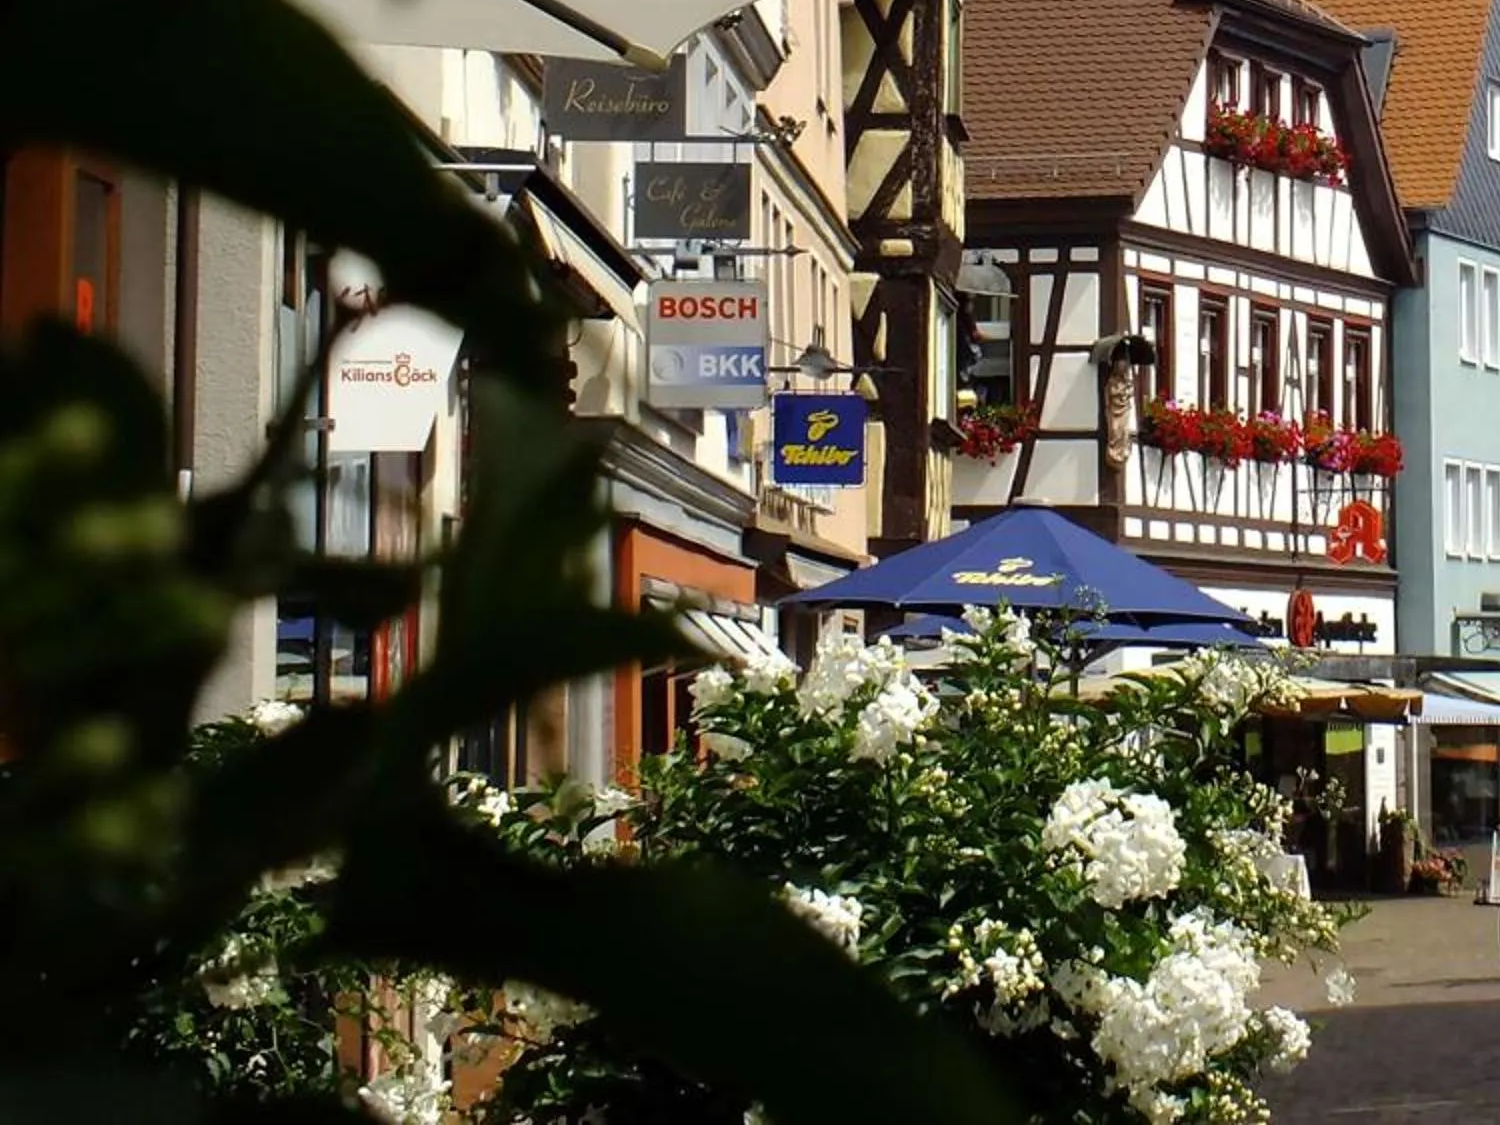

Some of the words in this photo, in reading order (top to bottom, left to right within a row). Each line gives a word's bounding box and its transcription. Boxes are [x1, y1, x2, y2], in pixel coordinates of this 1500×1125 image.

[659, 296, 758, 319] BOSCH
[701, 353, 761, 377] BKK
[780, 443, 859, 466] Tchibo
